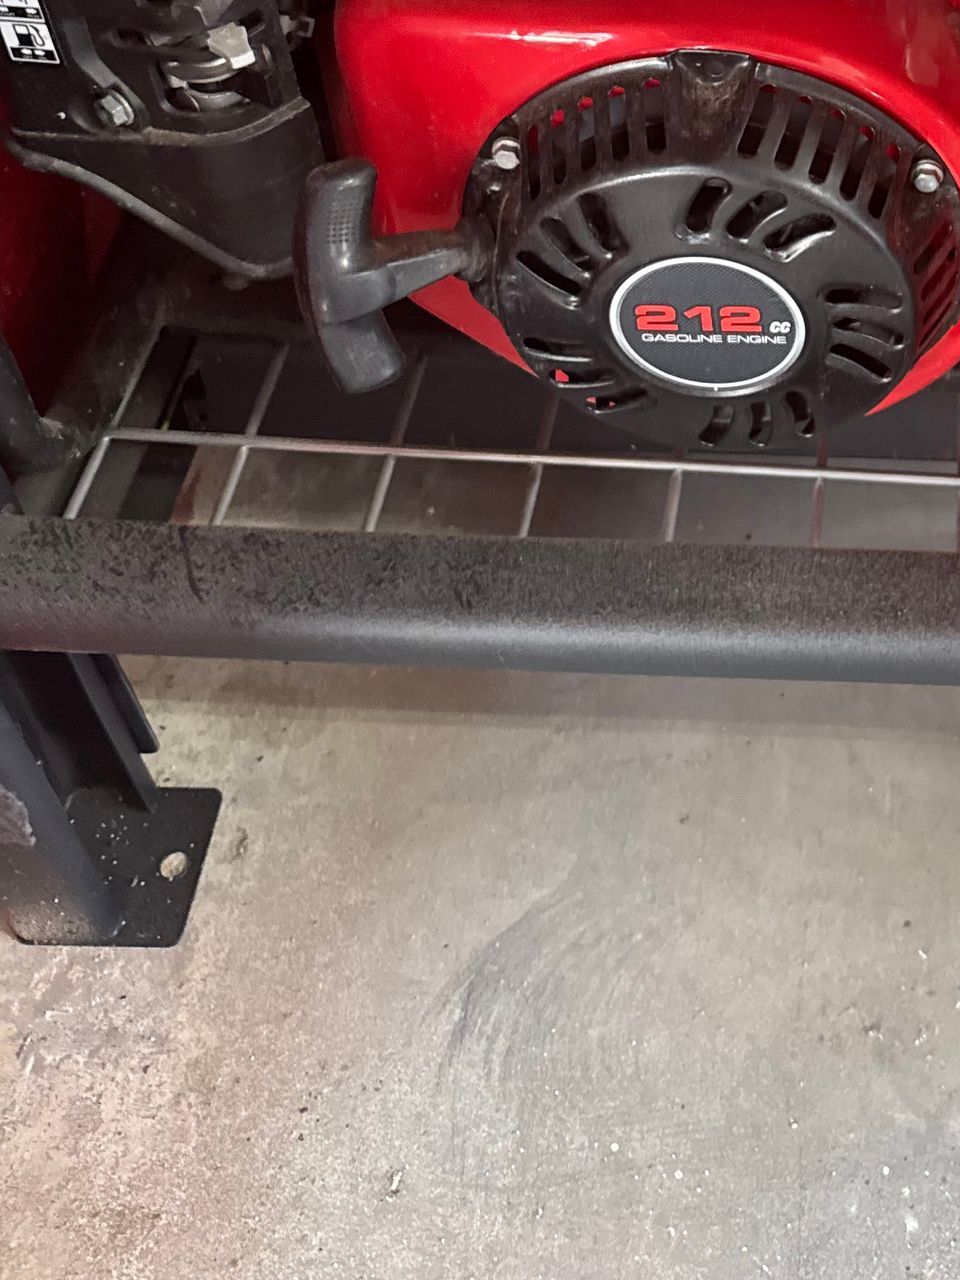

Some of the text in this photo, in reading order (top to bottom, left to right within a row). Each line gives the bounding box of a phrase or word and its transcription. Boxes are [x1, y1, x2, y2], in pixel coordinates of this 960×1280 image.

[634, 304, 762, 332] 212
[641, 333, 787, 345] GASOLINE ENGINE
